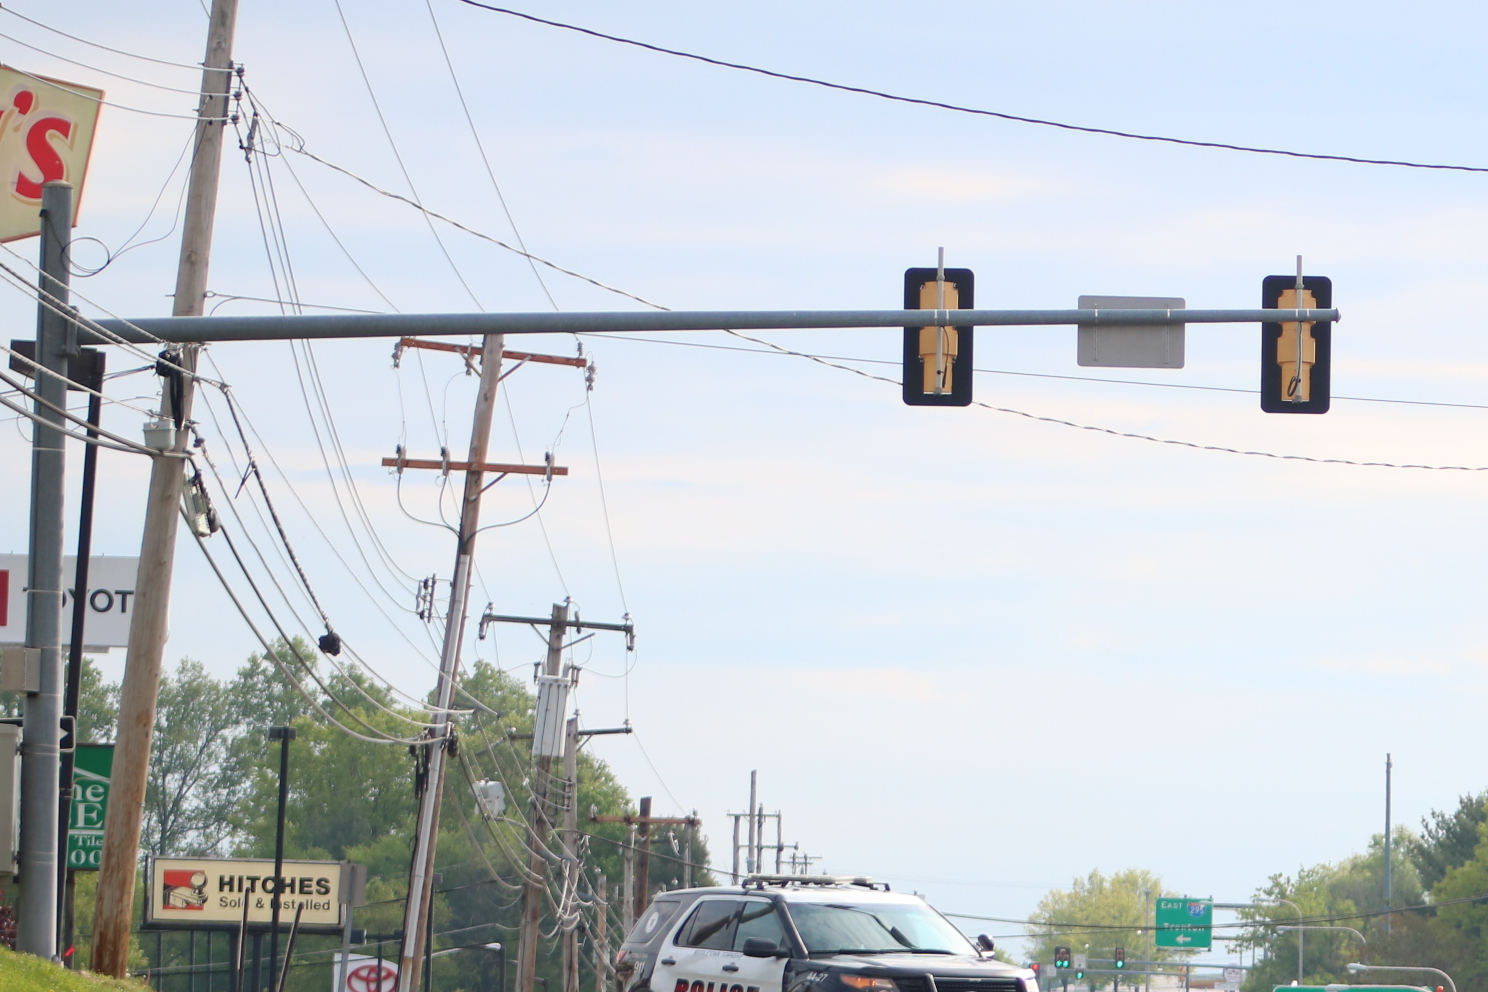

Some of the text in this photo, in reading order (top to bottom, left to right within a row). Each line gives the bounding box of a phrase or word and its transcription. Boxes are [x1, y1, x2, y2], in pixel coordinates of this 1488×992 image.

[219, 874, 331, 896] HITCHES
[255, 897, 265, 909] &
[1161, 901, 1205, 914] EAST 295
